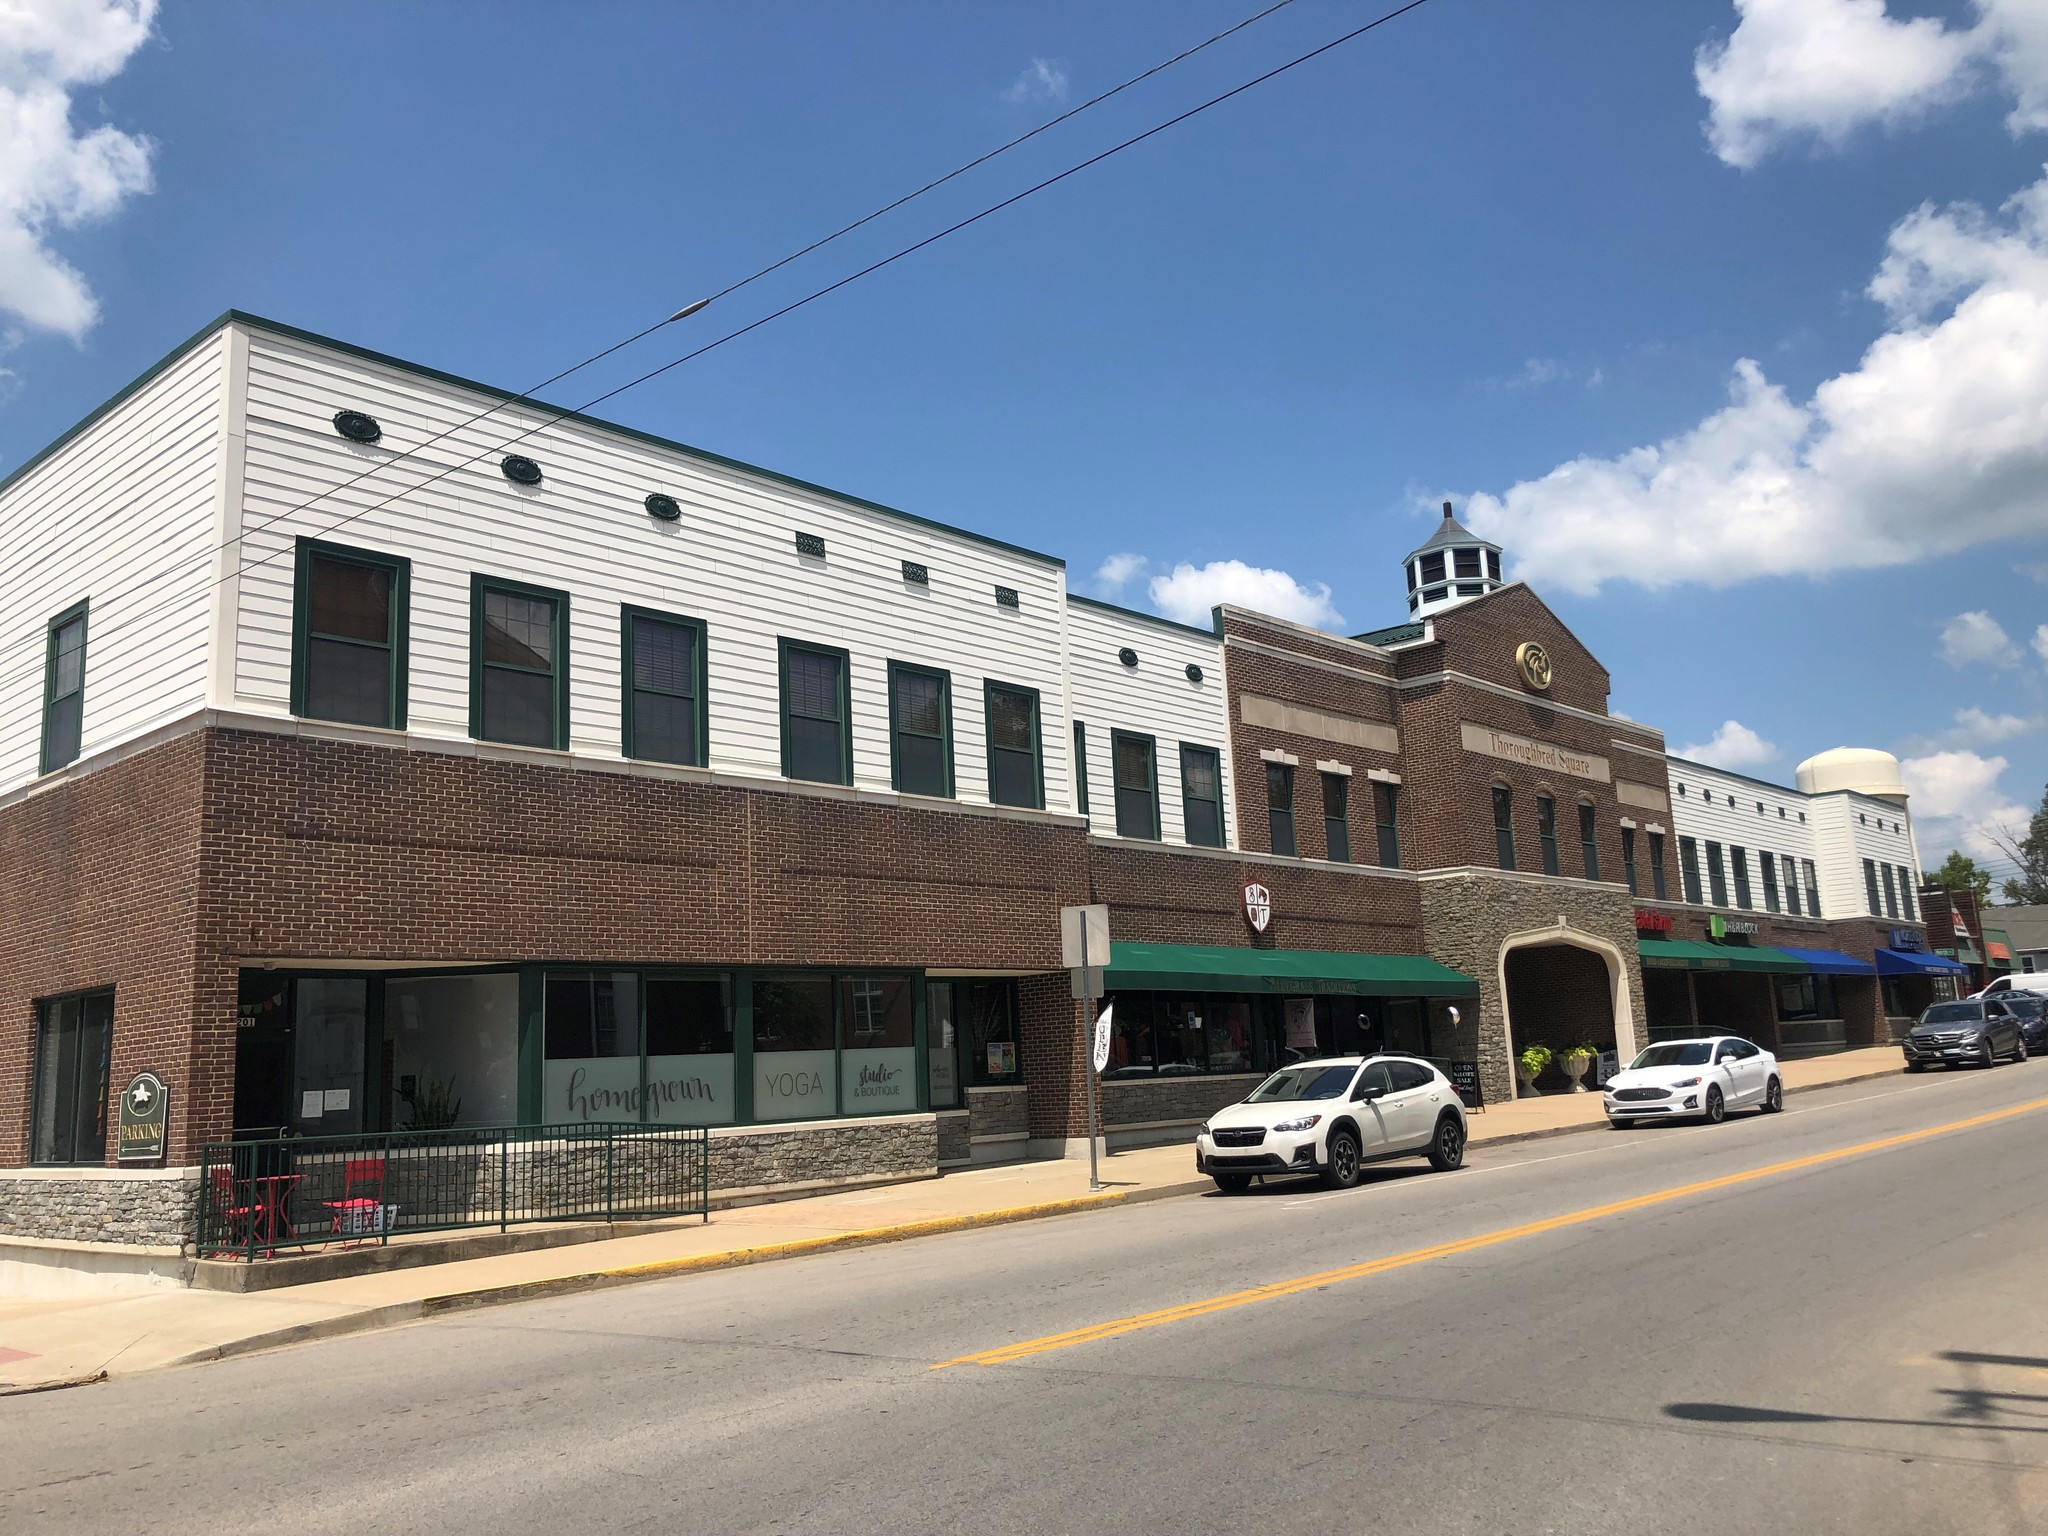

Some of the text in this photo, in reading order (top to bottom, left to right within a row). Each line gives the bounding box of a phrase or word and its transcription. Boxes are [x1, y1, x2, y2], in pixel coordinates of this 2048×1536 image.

[1488, 732, 1590, 774] Thoroughbred Square
[1260, 908, 1267, 924] T
[1727, 920, 1759, 935] H&R BLOCK
[237, 1018, 254, 1027] 201
[1095, 1024, 1107, 1062] OPEN
[765, 1072, 824, 1097] YOGA
[858, 1063, 903, 1087] studio
[565, 1067, 715, 1121] homegrown
[854, 1085, 900, 1098] & BOUTIQUE
[121, 1123, 162, 1140] PARKING
